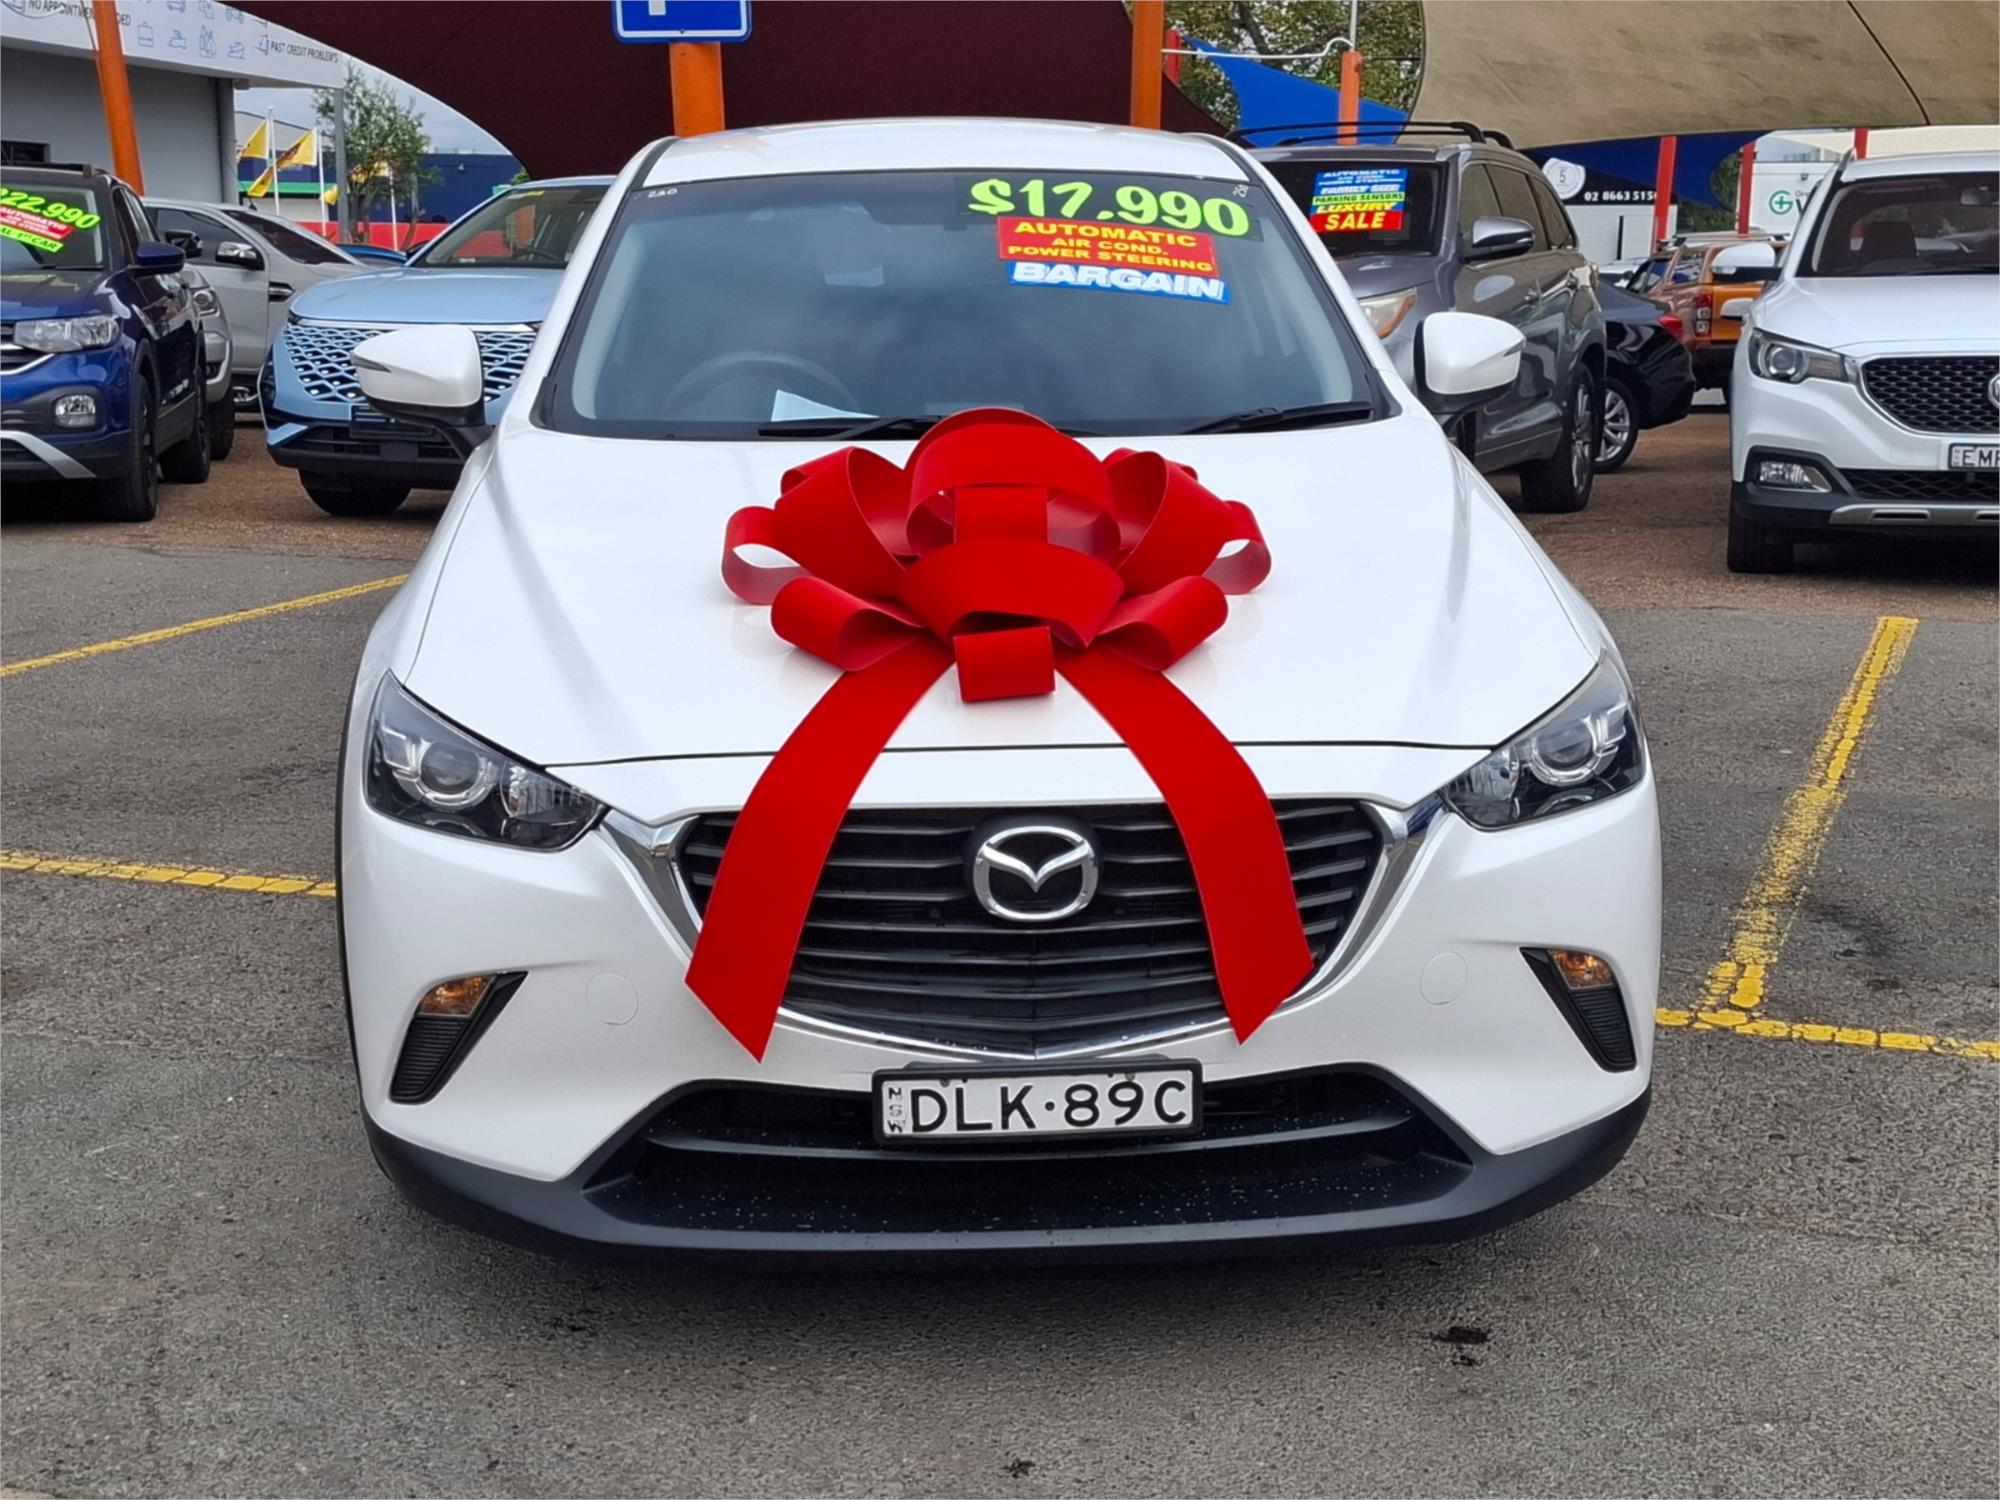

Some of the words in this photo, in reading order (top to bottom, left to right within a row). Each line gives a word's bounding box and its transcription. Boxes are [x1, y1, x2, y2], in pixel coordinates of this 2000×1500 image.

[270, 40, 285, 53] PAST
[286, 43, 306, 57] CREDIT
[1323, 169, 1400, 178] AUTOMATIC
[1315, 195, 1358, 203] PARKING
[1359, 193, 1404, 201] SENSORS
[1584, 191, 1599, 201] 02
[1602, 191, 1631, 201] 8663
[968, 178, 1249, 236] $17.990
[1316, 202, 1397, 214] LUXURY
[1325, 212, 1386, 230] SALE
[1014, 221, 1198, 247] AUTOMATIC
[32, 237, 57, 249] CAR
[1051, 238, 1091, 249] AIR
[1097, 240, 1169, 256] COND.
[1007, 246, 1091, 260] POWER
[1097, 252, 1213, 272] STEERING
[1013, 261, 1225, 301] BARGAIN
